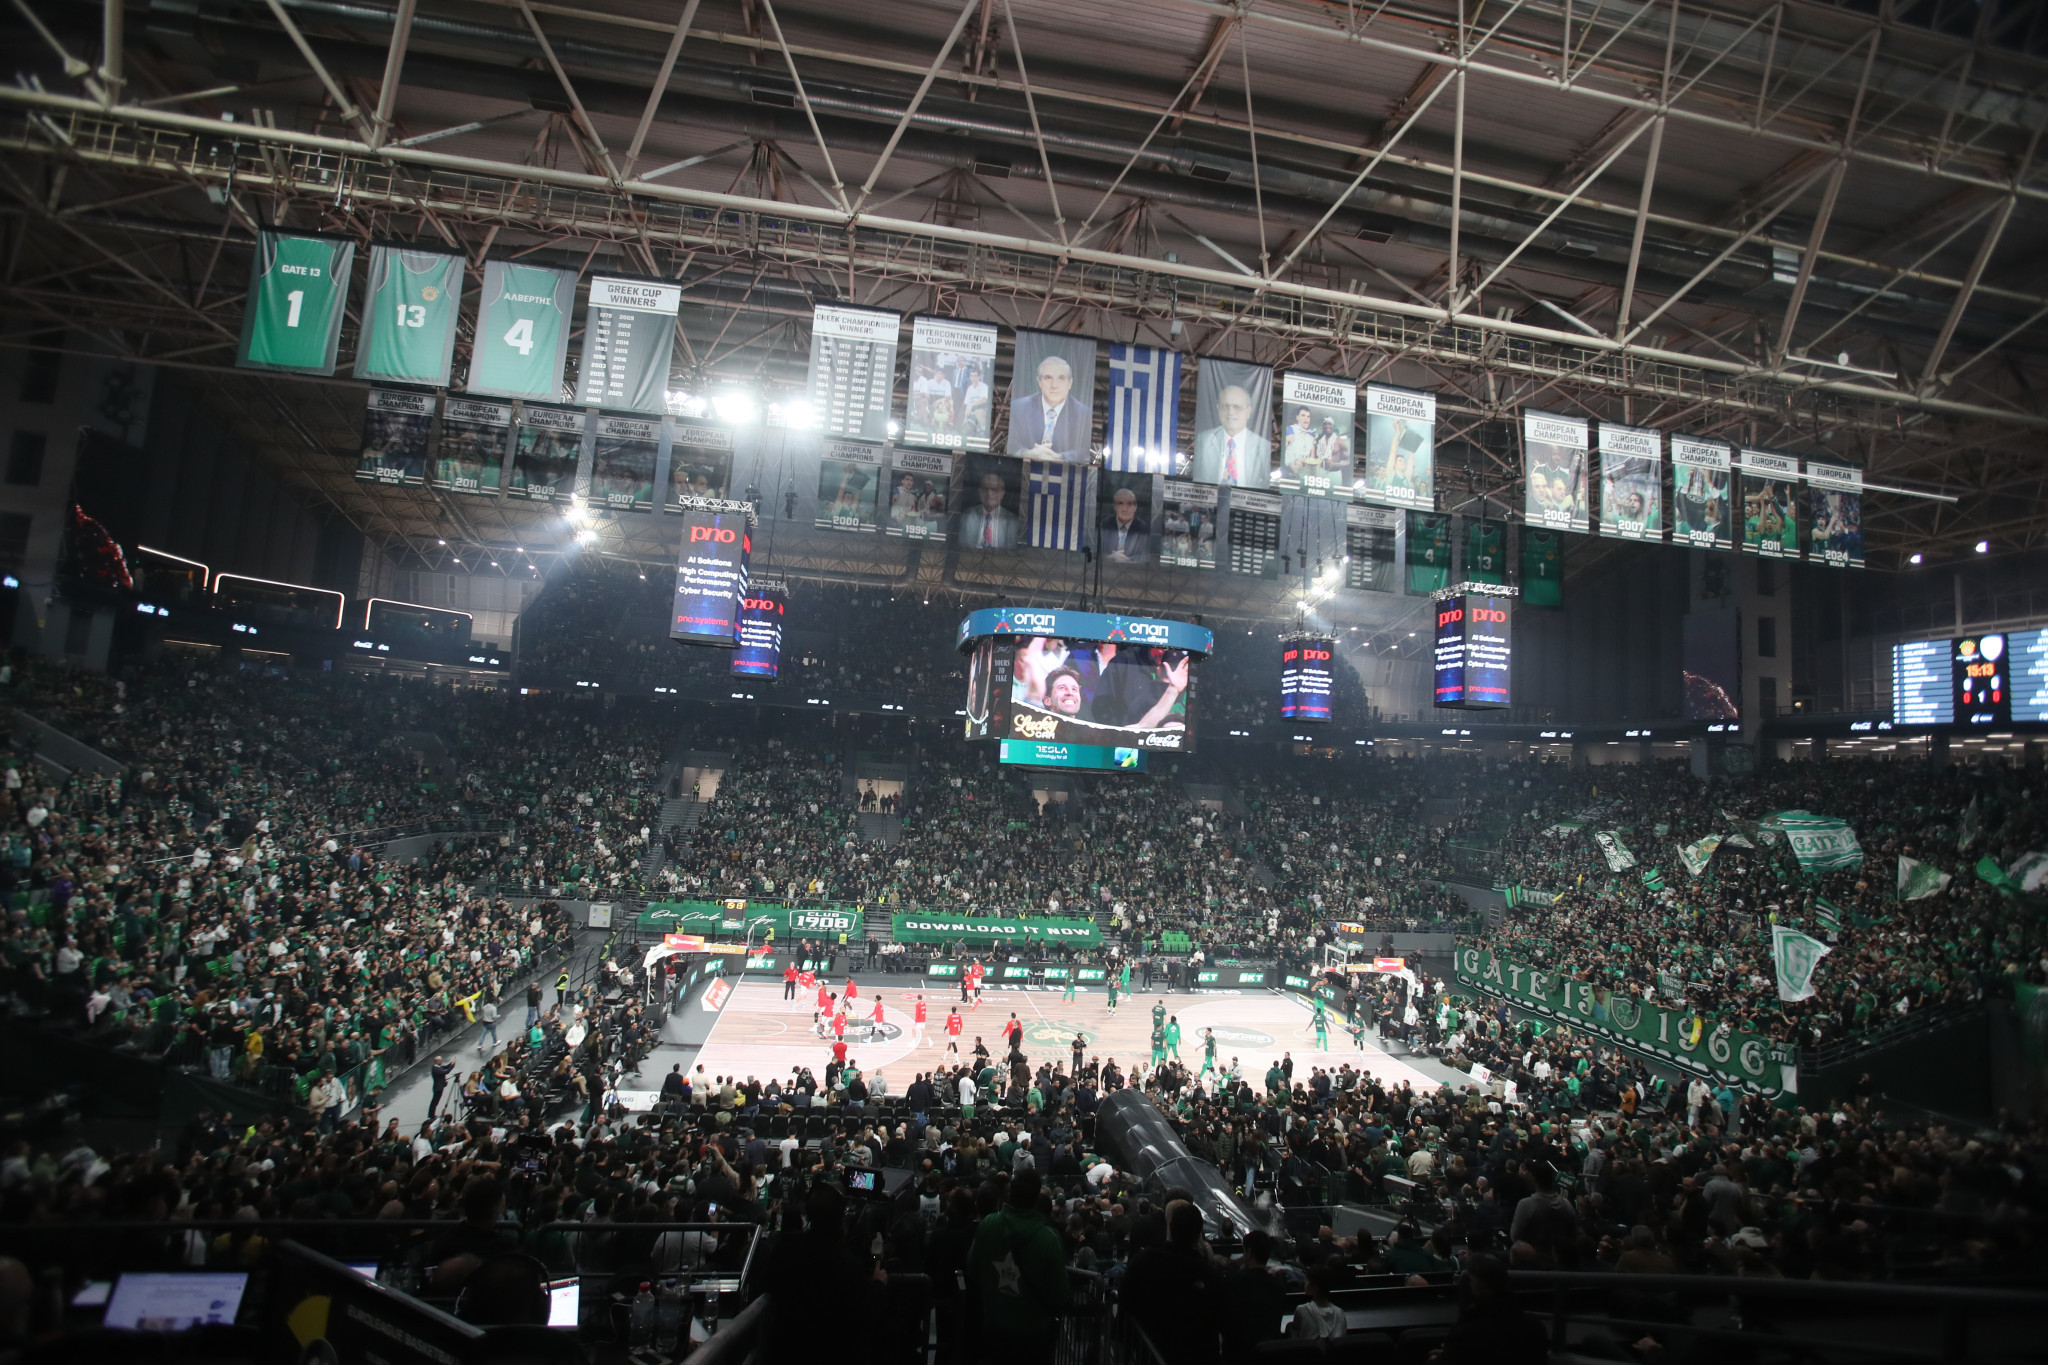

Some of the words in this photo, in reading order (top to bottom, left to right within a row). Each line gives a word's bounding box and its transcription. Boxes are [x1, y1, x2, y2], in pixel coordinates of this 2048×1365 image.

[282, 264, 307, 276] GATE
[309, 267, 321, 277] 13
[607, 284, 640, 296] GREEK
[641, 288, 662, 298] CUP
[503, 292, 551, 306] ΑΛΒΕΡΤΗΣ
[610, 294, 657, 307] WINNERS
[287, 290, 304, 328] 1
[396, 304, 426, 328] 13
[839, 324, 874, 334] WINNERS
[842, 317, 898, 329] CHAMPIONSHIP
[503, 318, 534, 356] 4
[916, 328, 992, 343] INTERCONTINENTAL
[945, 339, 982, 350] WINNERS
[1297, 382, 1343, 396] EUROPEAN
[381, 392, 424, 404] EUROPEAN
[1294, 391, 1346, 406] CHAMPIONS
[1380, 394, 1424, 408] EUROPEAN
[377, 400, 425, 411] CHAMPIONS
[457, 402, 499, 414] EUROPEAN
[1377, 402, 1426, 417] CHAMPIONS
[453, 410, 500, 422] CHAMPIONS
[532, 410, 574, 422] EUROPEAN
[529, 417, 575, 429] CHAMPIONS
[609, 421, 650, 431] EUROPEAN
[1536, 422, 1576, 434] EUROPEAN
[605, 427, 651, 438] CHAMPIONS
[685, 429, 725, 439] EUROPEAN
[1534, 429, 1579, 444] CHAMPIONS
[682, 435, 727, 446] CHAMPIONS
[932, 433, 962, 446] 1996
[1610, 434, 1650, 446] EUROPEAN
[834, 445, 872, 455] EUROPEAN
[1608, 441, 1652, 454] CHAMPIONS
[1682, 445, 1720, 458] EUROPEAN
[830, 451, 874, 462] CHAMPIONS
[904, 454, 941, 464] EUROPEAN
[1680, 452, 1722, 466] CHAMPIONS
[1751, 456, 1788, 468] EUROPEAN
[901, 460, 943, 471] CHAMPIONS
[376, 467, 404, 478] 2024
[1817, 468, 1852, 480] EUROPEAN
[455, 478, 478, 489] 2011
[1304, 475, 1330, 489] 1996
[527, 484, 556, 495] 2009
[1385, 486, 1415, 499] 2000
[608, 494, 634, 504] 2007
[833, 516, 859, 526] 2000
[1544, 508, 1570, 522] 2002
[906, 525, 927, 535] 1996
[1618, 519, 1644, 532] 2007
[690, 525, 736, 543] pno
[1690, 530, 1715, 542] 2009
[1761, 540, 1781, 551] 2011
[697, 557, 732, 567] Solutions
[1424, 549, 1434, 563] 4
[1824, 550, 1848, 562] 2024
[1178, 558, 1197, 567] 1996
[1477, 556, 1492, 570] 13
[679, 567, 696, 576] High
[698, 569, 738, 580] Computing
[1539, 562, 1545, 576] 1
[684, 576, 731, 588] Performance
[679, 587, 701, 596] Cyber
[702, 589, 733, 599] Security
[743, 598, 774, 610] pno
[677, 615, 729, 626] pno.systems
[1439, 609, 1463, 627] pno
[1472, 608, 1506, 623] pno
[1966, 662, 1995, 677] 15:13
[1963, 692, 1971, 704] 0
[1978, 690, 1985, 703] 1
[1992, 690, 2001, 703] 0
[1014, 714, 1058, 738] Lucky
[1036, 745, 1068, 754] TESLA
[1793, 836, 1838, 852] GATE
[650, 910, 680, 919] One
[681, 911, 721, 921] Club
[797, 915, 848, 929] 1908
[906, 921, 1016, 934] DOWNLOAD
[1024, 926, 1040, 934] IT
[1047, 927, 1090, 936] NOW
[706, 960, 724, 971] BKT
[930, 966, 956, 976] BKT
[1079, 970, 1104, 979] BKT
[1239, 974, 1264, 982] BKT
[1286, 977, 1309, 987] BKT
[1464, 949, 1548, 1002] GATE
[1658, 1012, 1765, 1076] 1966
